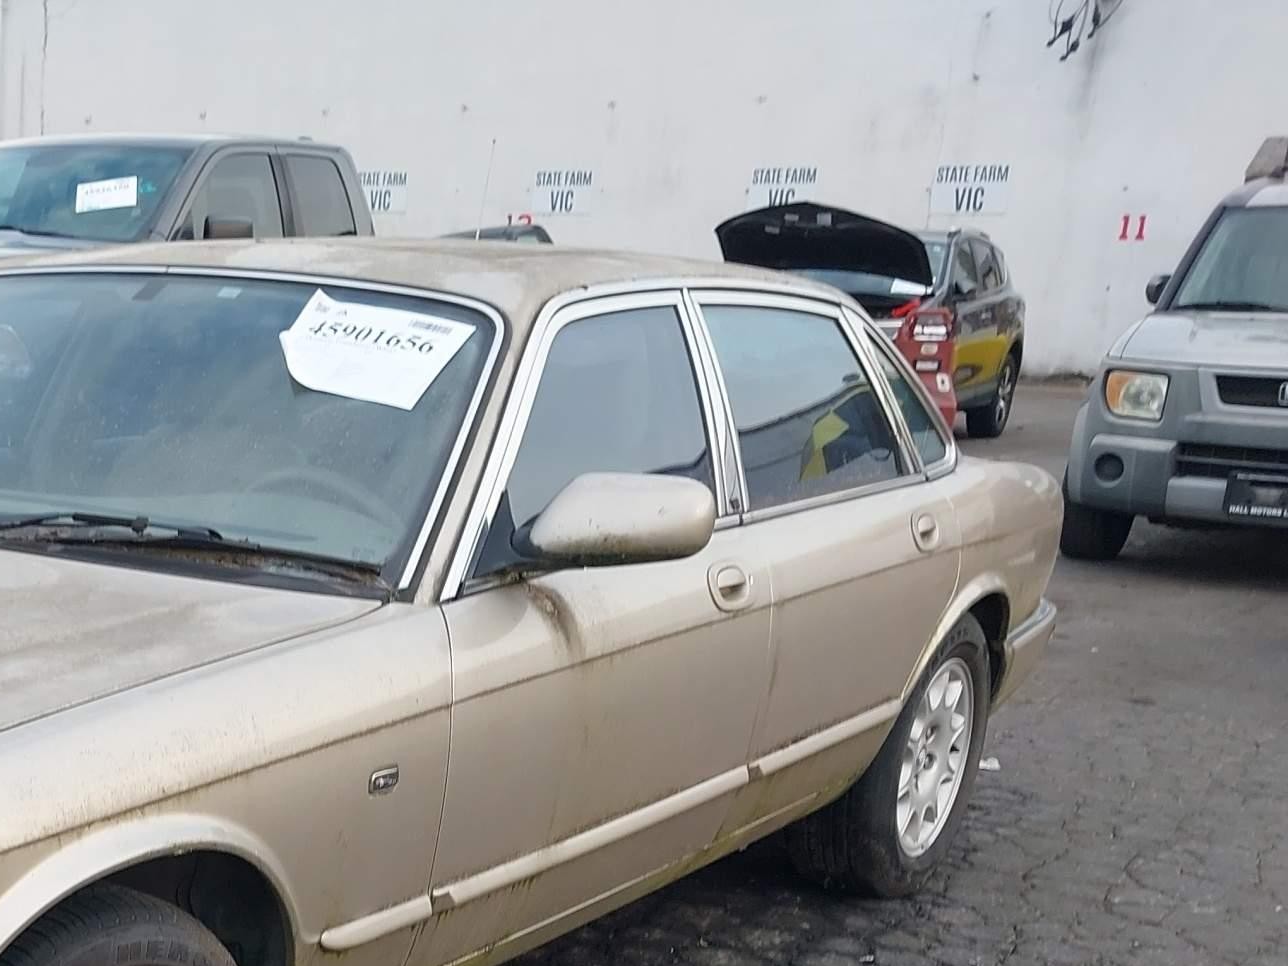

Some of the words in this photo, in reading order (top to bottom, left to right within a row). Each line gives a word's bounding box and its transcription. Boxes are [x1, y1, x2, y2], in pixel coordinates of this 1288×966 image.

[359, 171, 381, 187] TATE
[382, 171, 408, 187] FARM
[535, 170, 562, 187] STATE
[564, 170, 593, 187] FARM
[752, 167, 782, 185] STATE
[784, 167, 817, 184] FARM
[937, 165, 970, 183] STATE
[973, 164, 1009, 183] FARM
[370, 189, 391, 211] VIC
[550, 190, 573, 212] VIC
[768, 188, 795, 207] VIC
[955, 186, 985, 212] VIC
[1119, 214, 1147, 241] 11
[309, 319, 434, 356] 45901656
